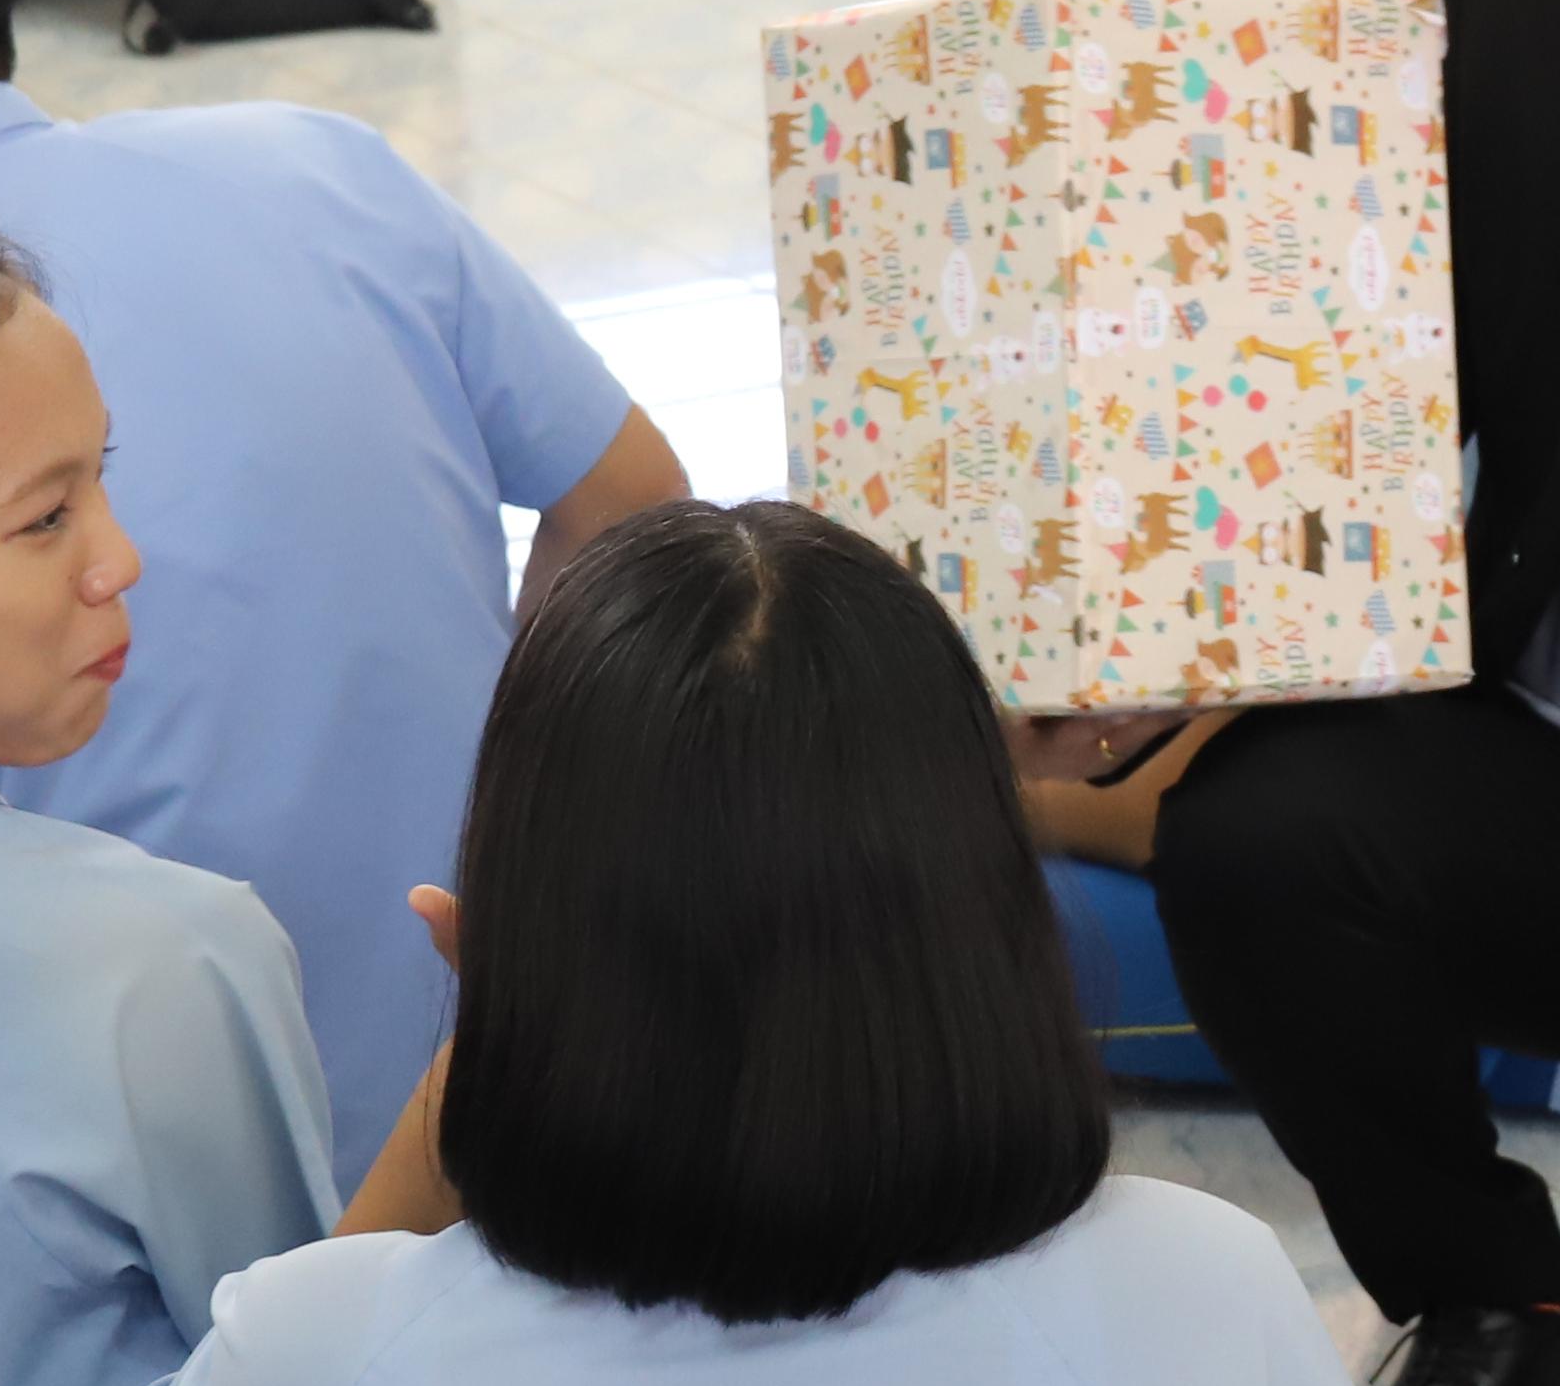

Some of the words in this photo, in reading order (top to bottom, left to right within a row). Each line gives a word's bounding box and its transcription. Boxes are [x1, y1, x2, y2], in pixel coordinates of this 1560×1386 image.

[859, 247, 883, 328] HAPPY
[874, 225, 905, 348] BIRTHDAY
[1245, 211, 1269, 297] HAPPY
[1268, 190, 1299, 318] BIRTHDAY
[952, 417, 973, 502] HAPPY
[969, 396, 997, 525] BIRTHDAY
[1359, 389, 1383, 474] HAPPY
[1380, 370, 1410, 494] BIRTHDAY
